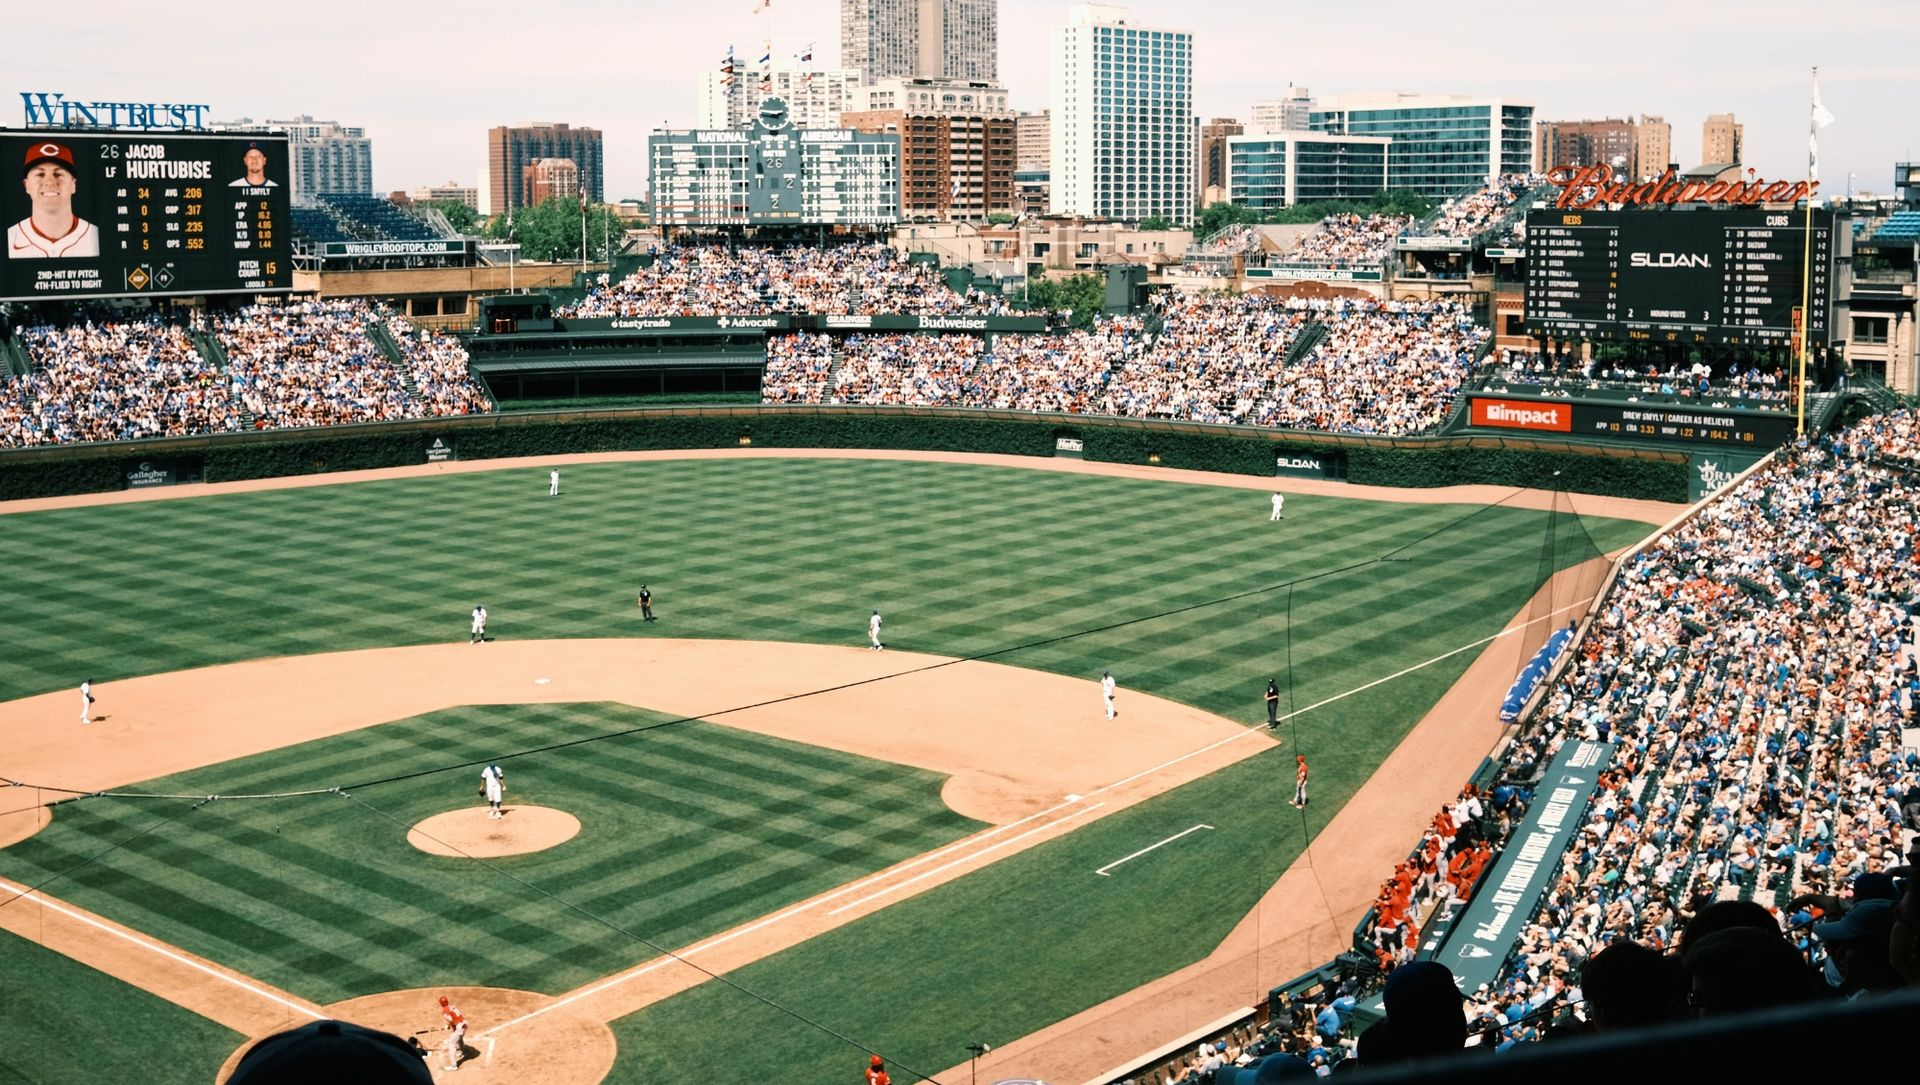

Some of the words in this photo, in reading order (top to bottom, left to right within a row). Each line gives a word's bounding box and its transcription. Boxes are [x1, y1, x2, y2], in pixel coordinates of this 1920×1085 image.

[20, 92, 210, 130] WINTRUST
[697, 132, 748, 142] NATIONAL
[801, 131, 852, 142] AMERICAN
[101, 145, 119, 158] 26
[126, 145, 164, 159] JACOB
[767, 159, 782, 168] 26
[105, 167, 116, 178] LF
[126, 161, 211, 178] HURTUBISE
[787, 179, 793, 188] 2
[1548, 162, 1820, 210] Budweiser
[138, 188, 149, 198] 34
[165, 189, 178, 197] AVG
[183, 188, 202, 198] .206
[772, 199, 778, 208] 2
[141, 206, 148, 215] 0
[185, 205, 201, 215] .317
[1563, 215, 1581, 224] REDS
[1766, 216, 1788, 226] CUBS
[143, 223, 148, 232] 3
[185, 222, 203, 232] .235
[143, 240, 148, 249] 5
[186, 239, 203, 249] .552
[346, 242, 446, 254] WRIGLEYROOFTOPS.COM
[1631, 252, 1708, 268] SLOAN
[266, 262, 276, 274] 15
[78, 270, 98, 278] PITCH
[35, 281, 70, 290] 4TH-FLIED
[82, 280, 102, 288] RIGHT
[1628, 309, 1633, 317] 2
[1704, 311, 1709, 320] 3
[619, 319, 670, 329] tastytrade
[732, 318, 778, 327] Advocate
[918, 316, 988, 329] Budweiser
[1500, 404, 1558, 424] impact
[1623, 411, 1641, 420] DREW
[1643, 412, 1664, 421] SMYLY
[1668, 415, 1692, 424] CAREER
[1704, 417, 1734, 426] RELIEVER
[1277, 458, 1320, 469] SLOAN
[127, 470, 167, 479] Gallagher
